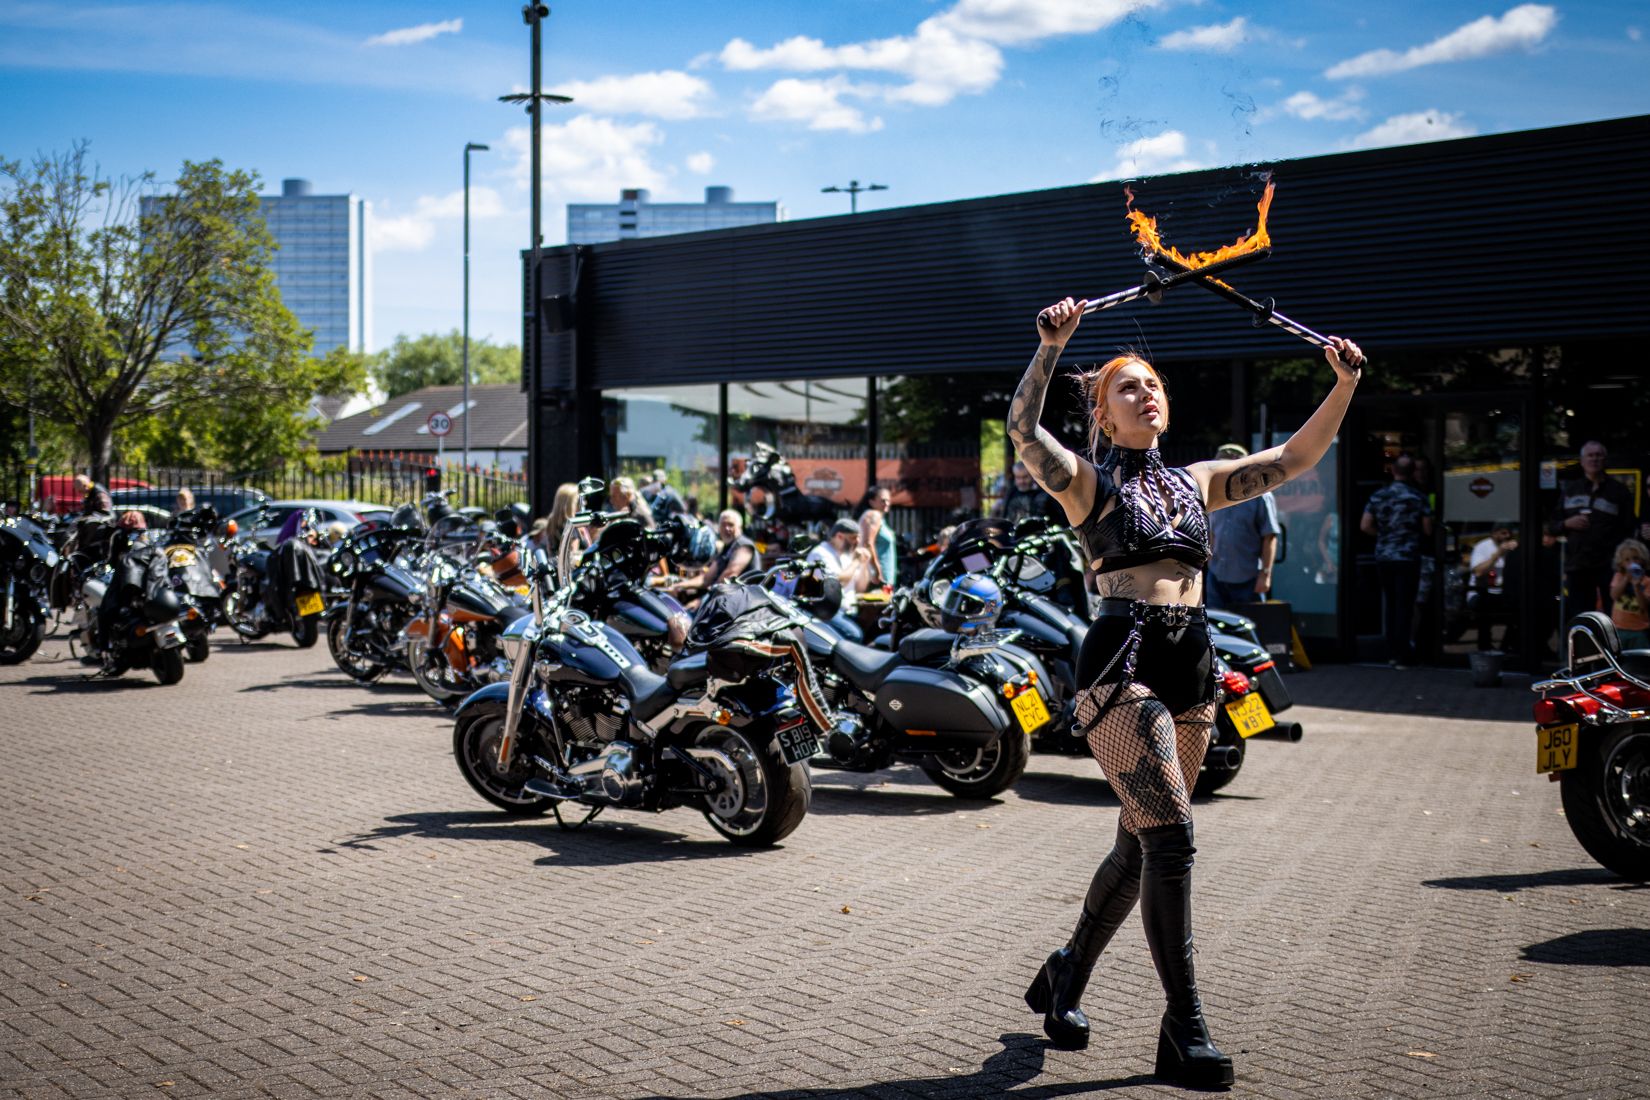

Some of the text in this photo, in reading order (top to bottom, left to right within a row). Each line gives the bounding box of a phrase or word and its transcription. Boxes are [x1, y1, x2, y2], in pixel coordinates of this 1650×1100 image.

[431, 417, 449, 430] 30
[1014, 691, 1039, 714] NL21
[1023, 707, 1044, 728] CYC
[791, 739, 819, 760] HOG
[1543, 727, 1571, 750] J60
[1543, 747, 1571, 770] JLY
